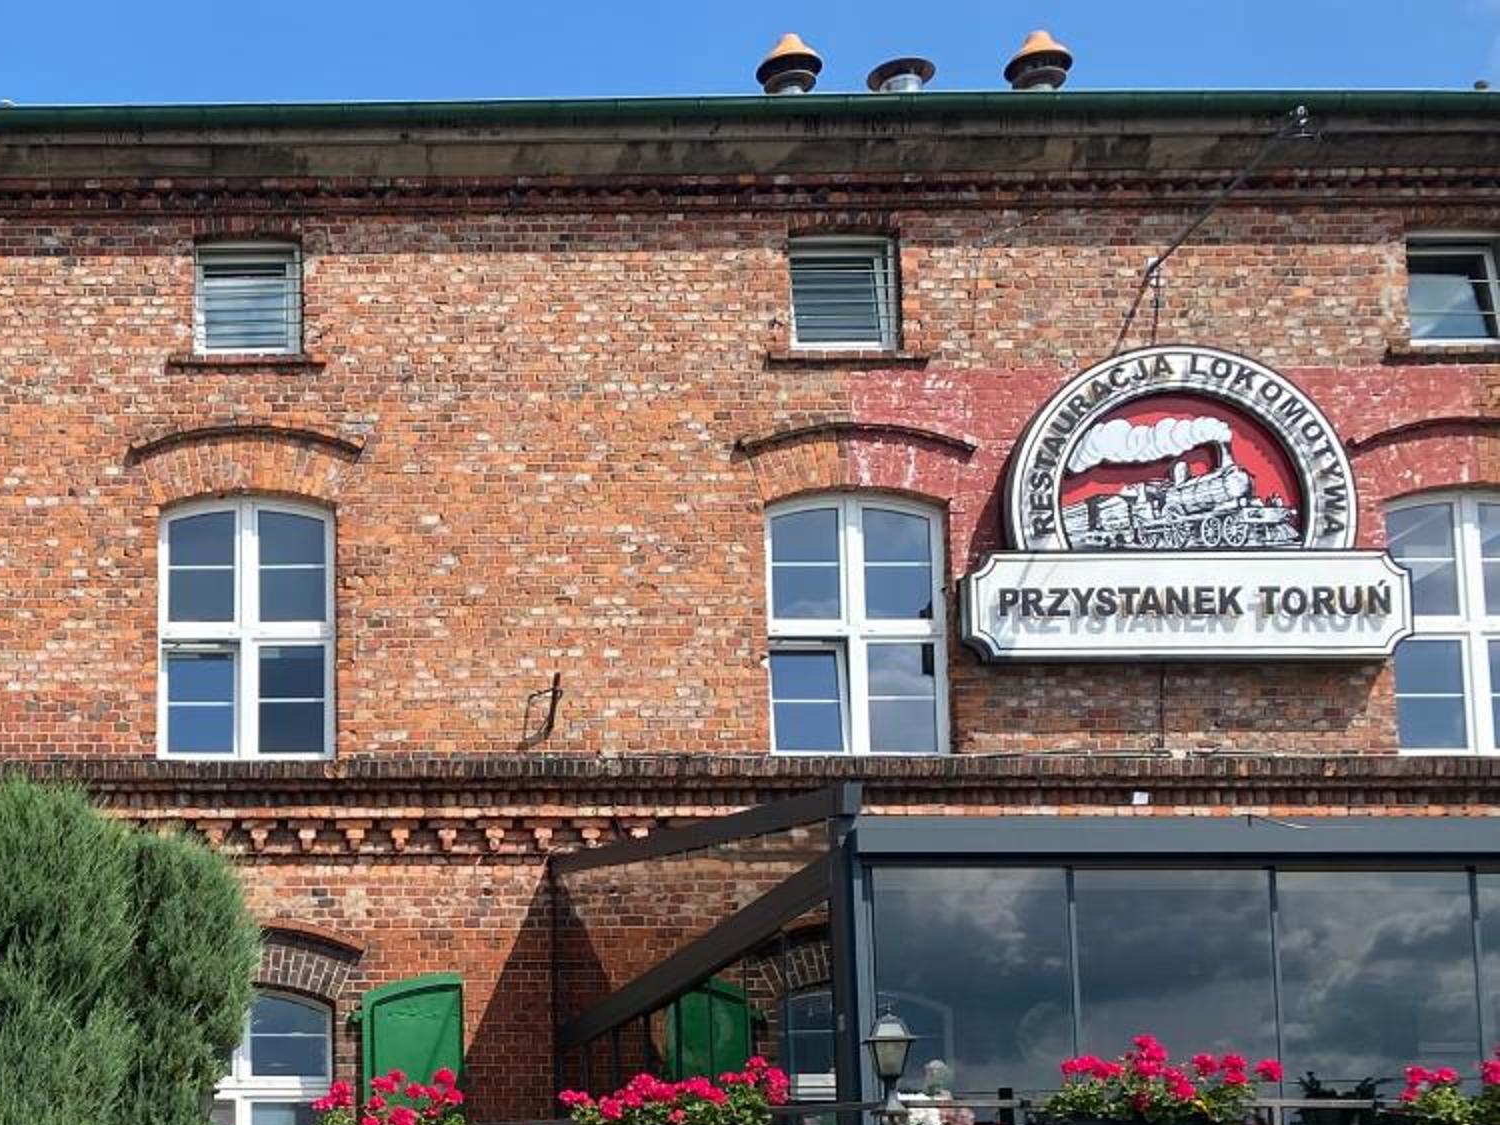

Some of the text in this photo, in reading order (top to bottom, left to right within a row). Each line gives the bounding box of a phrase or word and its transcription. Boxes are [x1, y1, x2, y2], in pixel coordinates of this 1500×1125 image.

[1031, 352, 1349, 537] RESTAURACJA LOKOMOTYWA
[998, 579, 1392, 618] PRZYSTANEK TORUŃ
